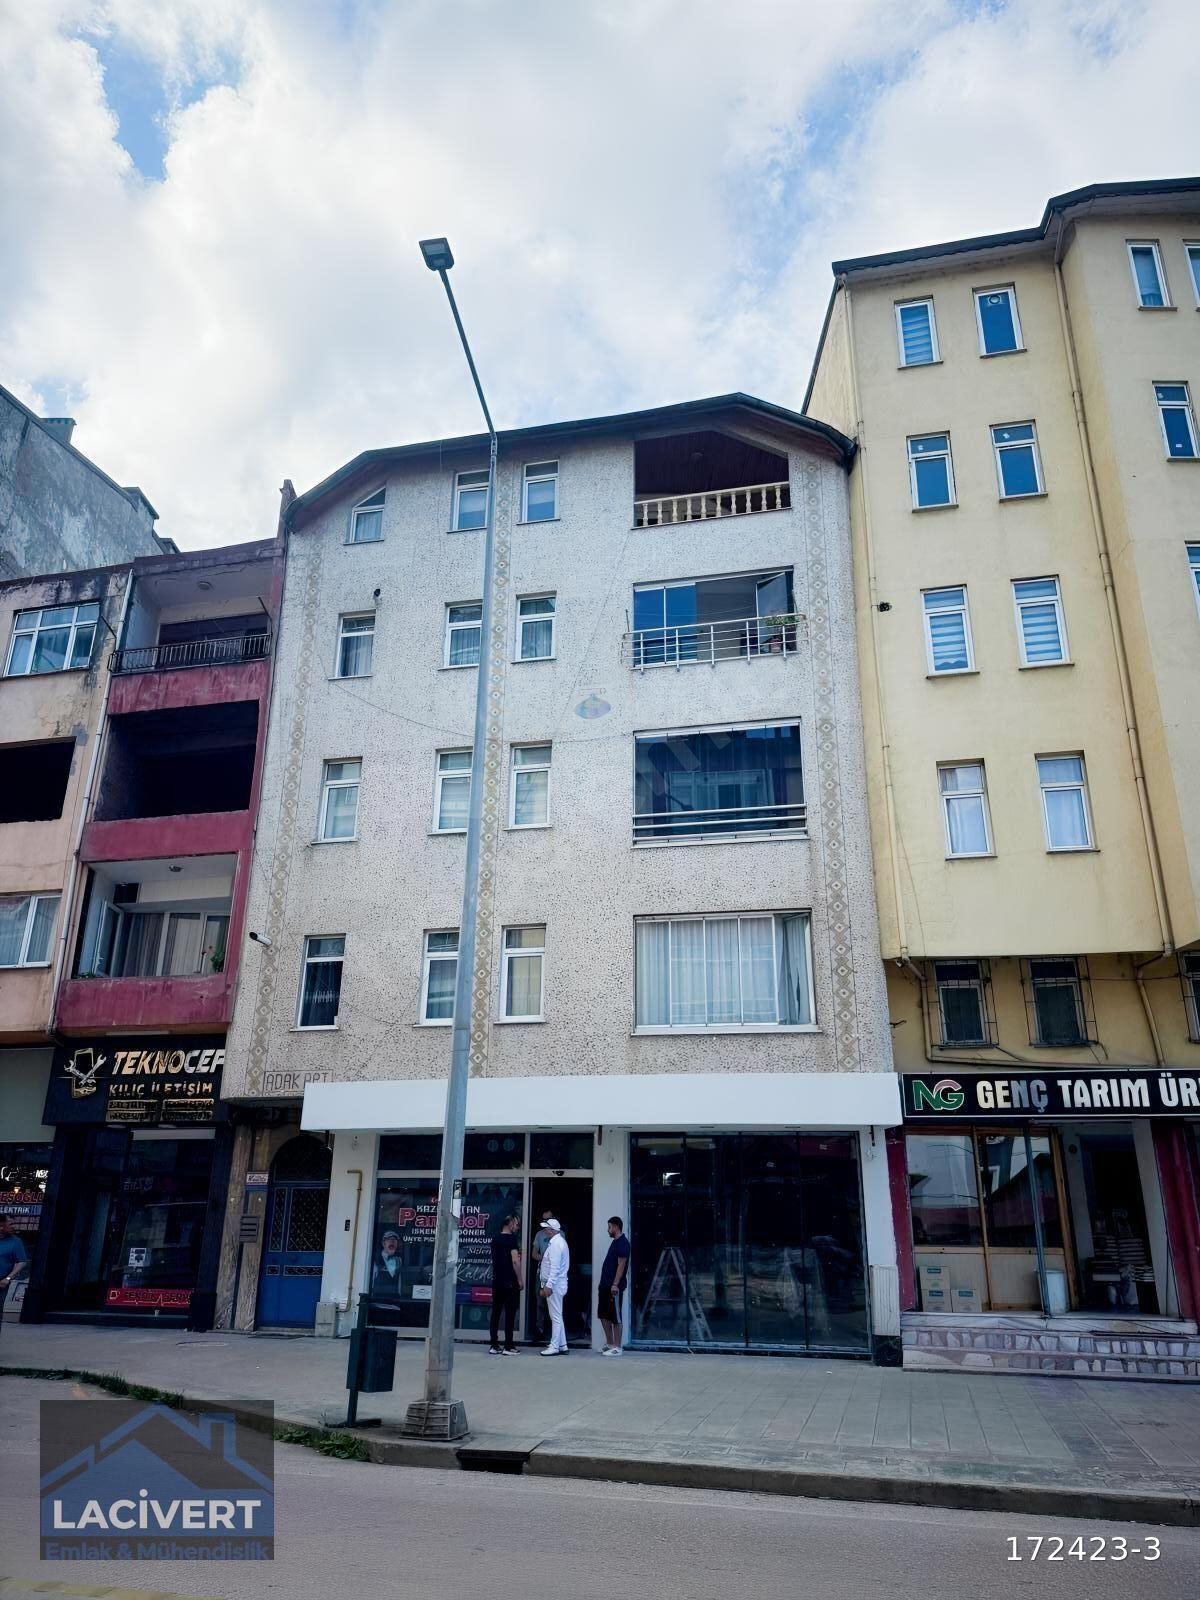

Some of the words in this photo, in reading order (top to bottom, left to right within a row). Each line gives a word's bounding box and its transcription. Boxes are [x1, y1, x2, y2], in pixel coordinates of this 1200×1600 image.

[266, 1073, 300, 1091] ADAK
[912, 1079, 965, 1111] NG
[976, 1080, 1049, 1113] GENÇ
[1057, 1078, 1150, 1109] TARIM
[1158, 1072, 1200, 1108] ÜR
